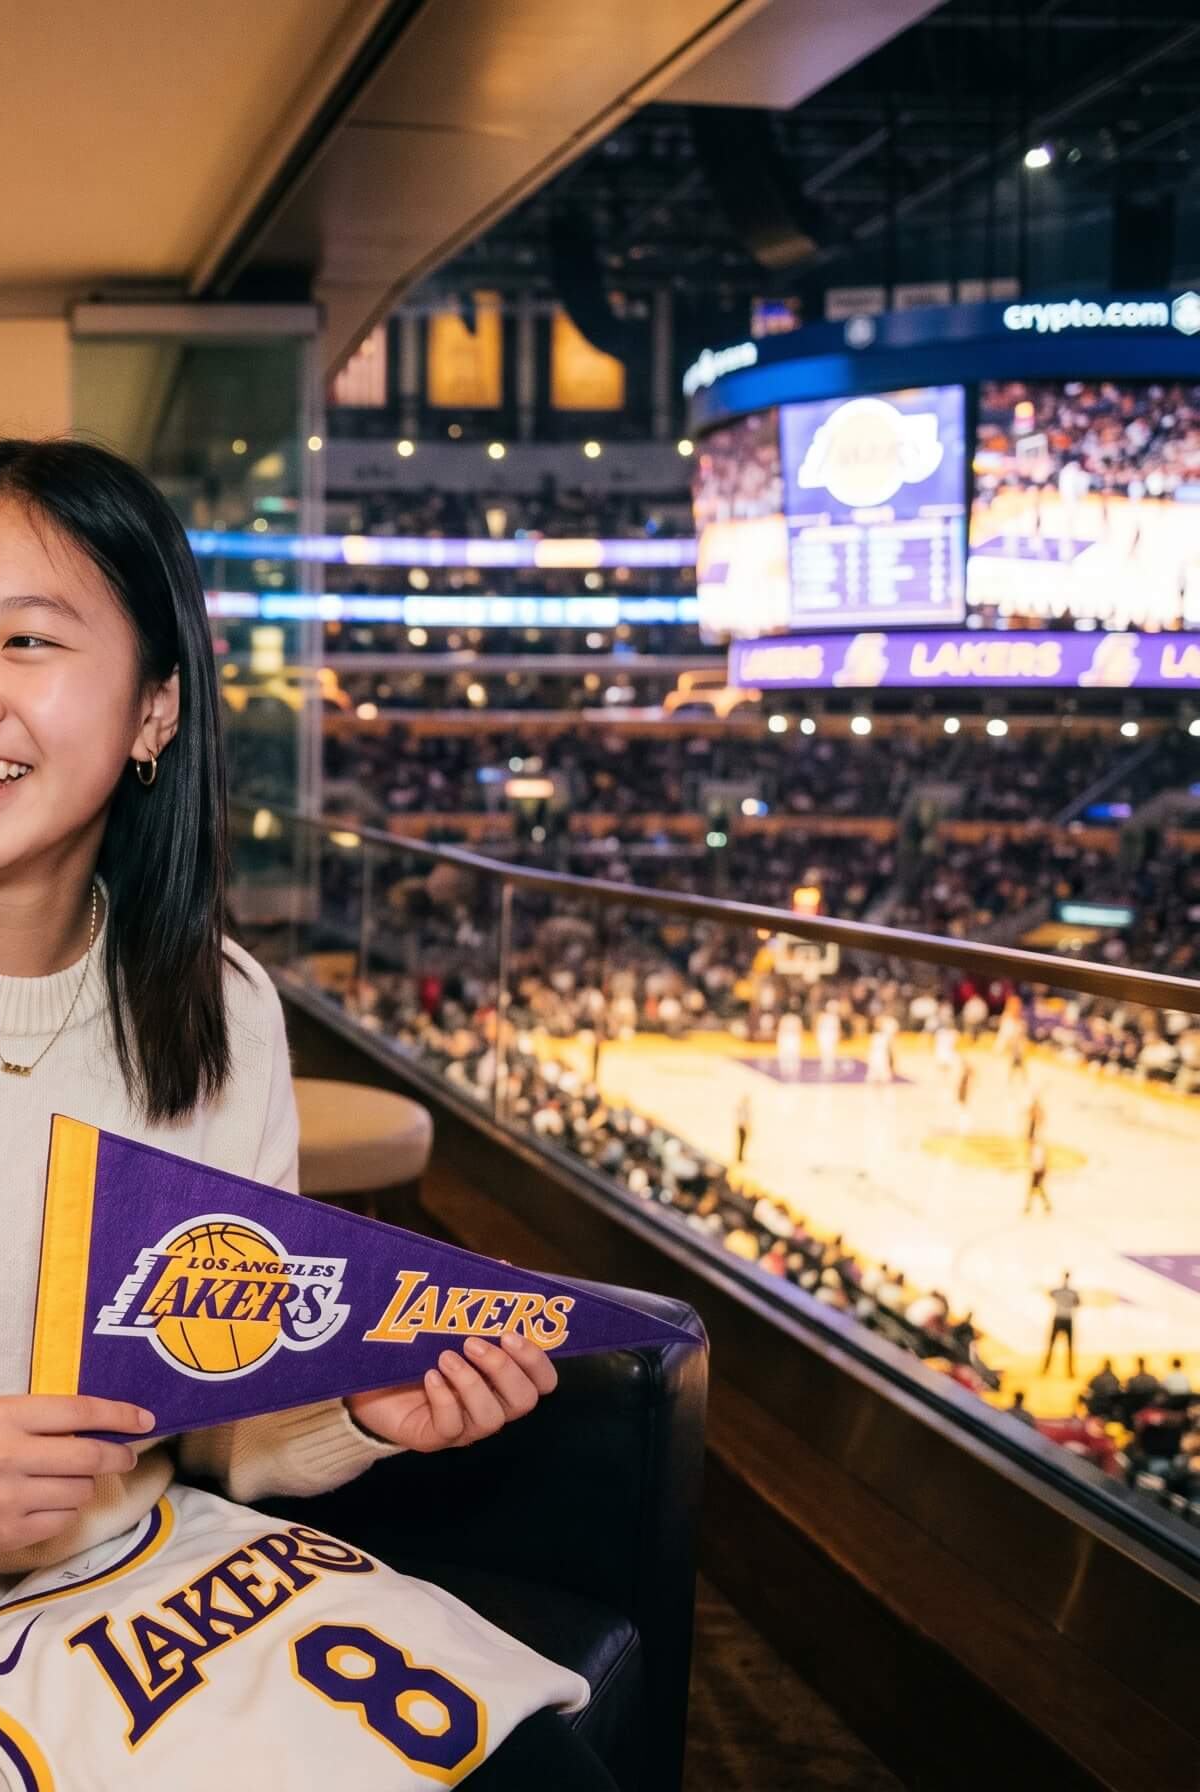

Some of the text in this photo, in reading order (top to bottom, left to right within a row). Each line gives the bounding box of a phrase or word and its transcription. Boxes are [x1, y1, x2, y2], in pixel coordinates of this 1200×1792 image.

[1003, 300, 1168, 333] crypto.com
[909, 642, 1062, 678] LAKERS
[108, 1254, 341, 1342] LAKERS
[187, 1256, 336, 1278] LOS ANGELES
[362, 1270, 576, 1351] LAKERS
[63, 1524, 383, 1754] LAKERS
[289, 1622, 488, 1787] 8
